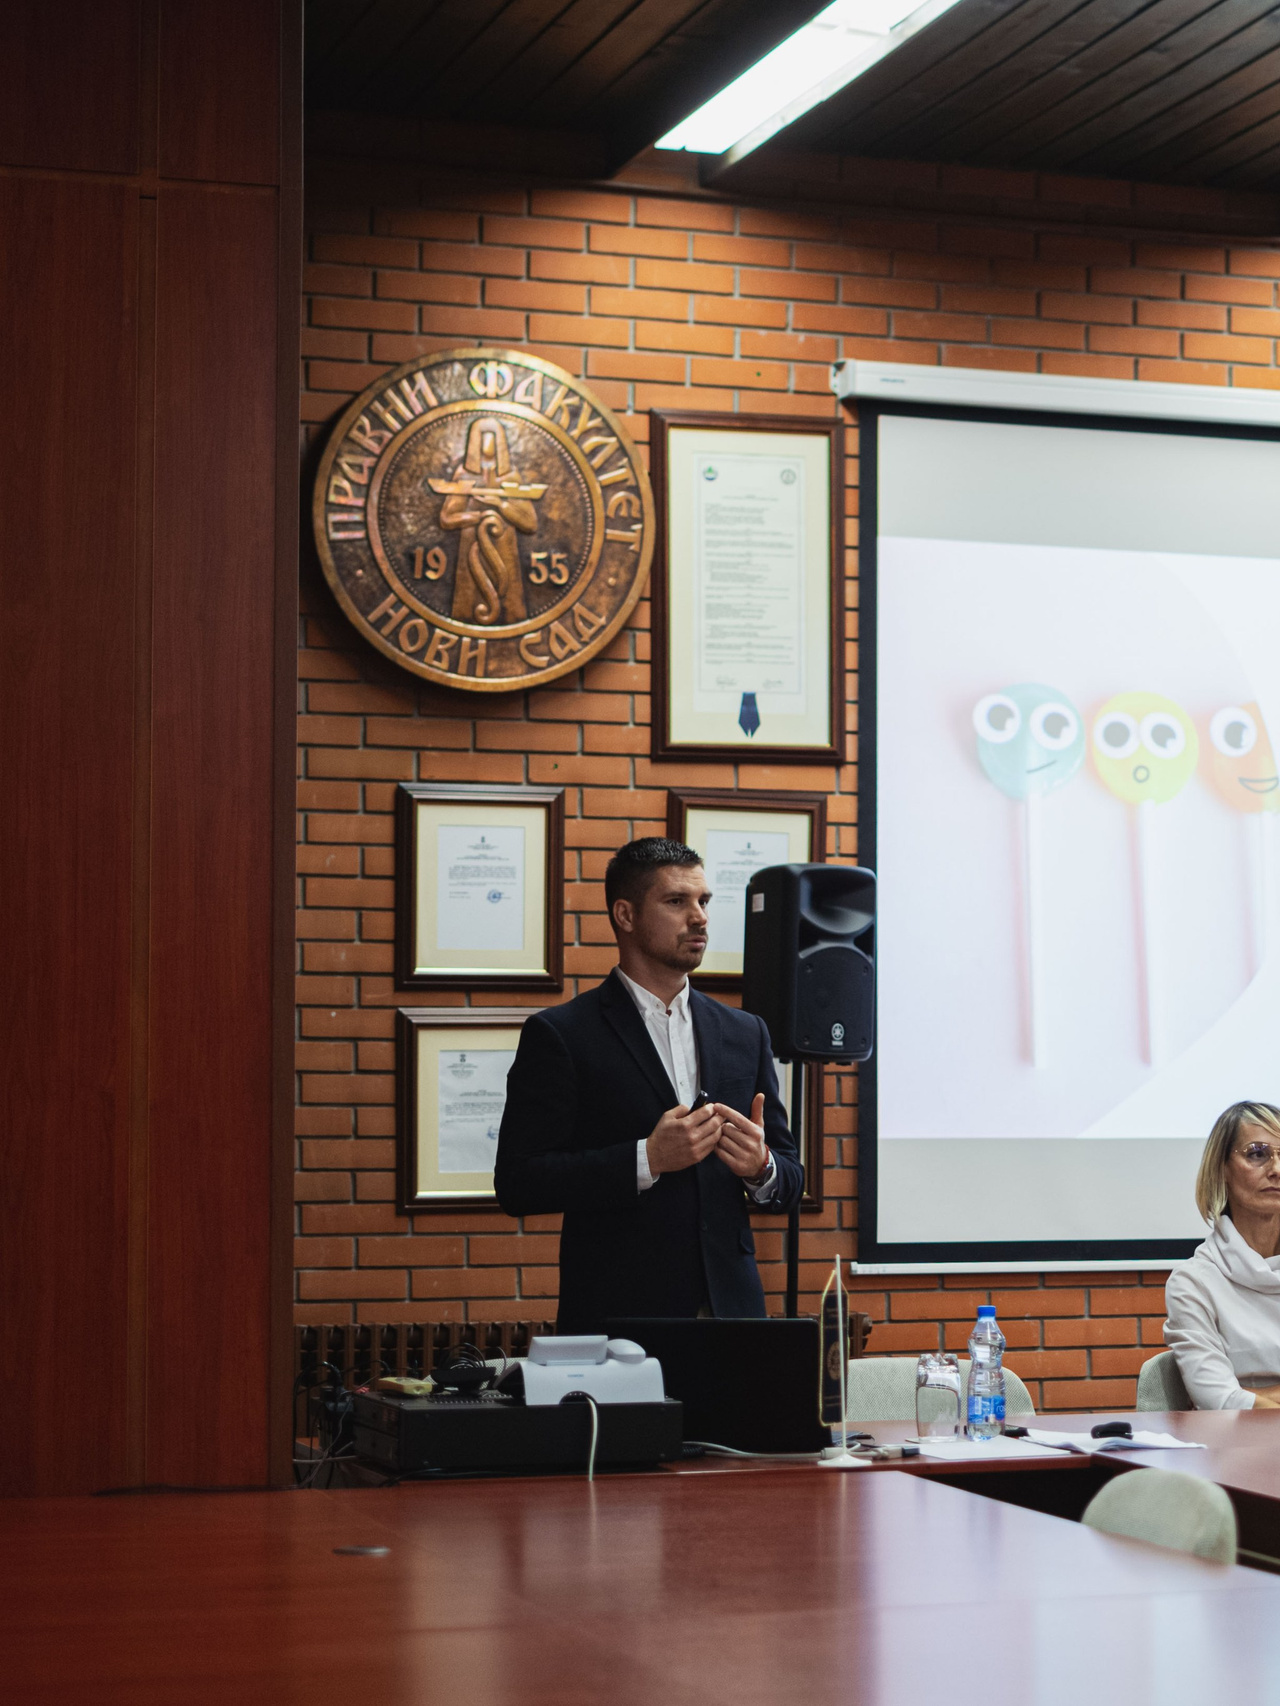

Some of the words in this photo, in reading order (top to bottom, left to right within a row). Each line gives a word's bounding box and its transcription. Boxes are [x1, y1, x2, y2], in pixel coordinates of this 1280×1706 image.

[327, 371, 438, 540] ПРАВНИ
[469, 360, 642, 553] ФАКУЛТЕТ
[411, 547, 447, 580] 19
[529, 551, 570, 585] 55
[367, 593, 487, 677] НОВИ
[519, 602, 606, 669] САД
